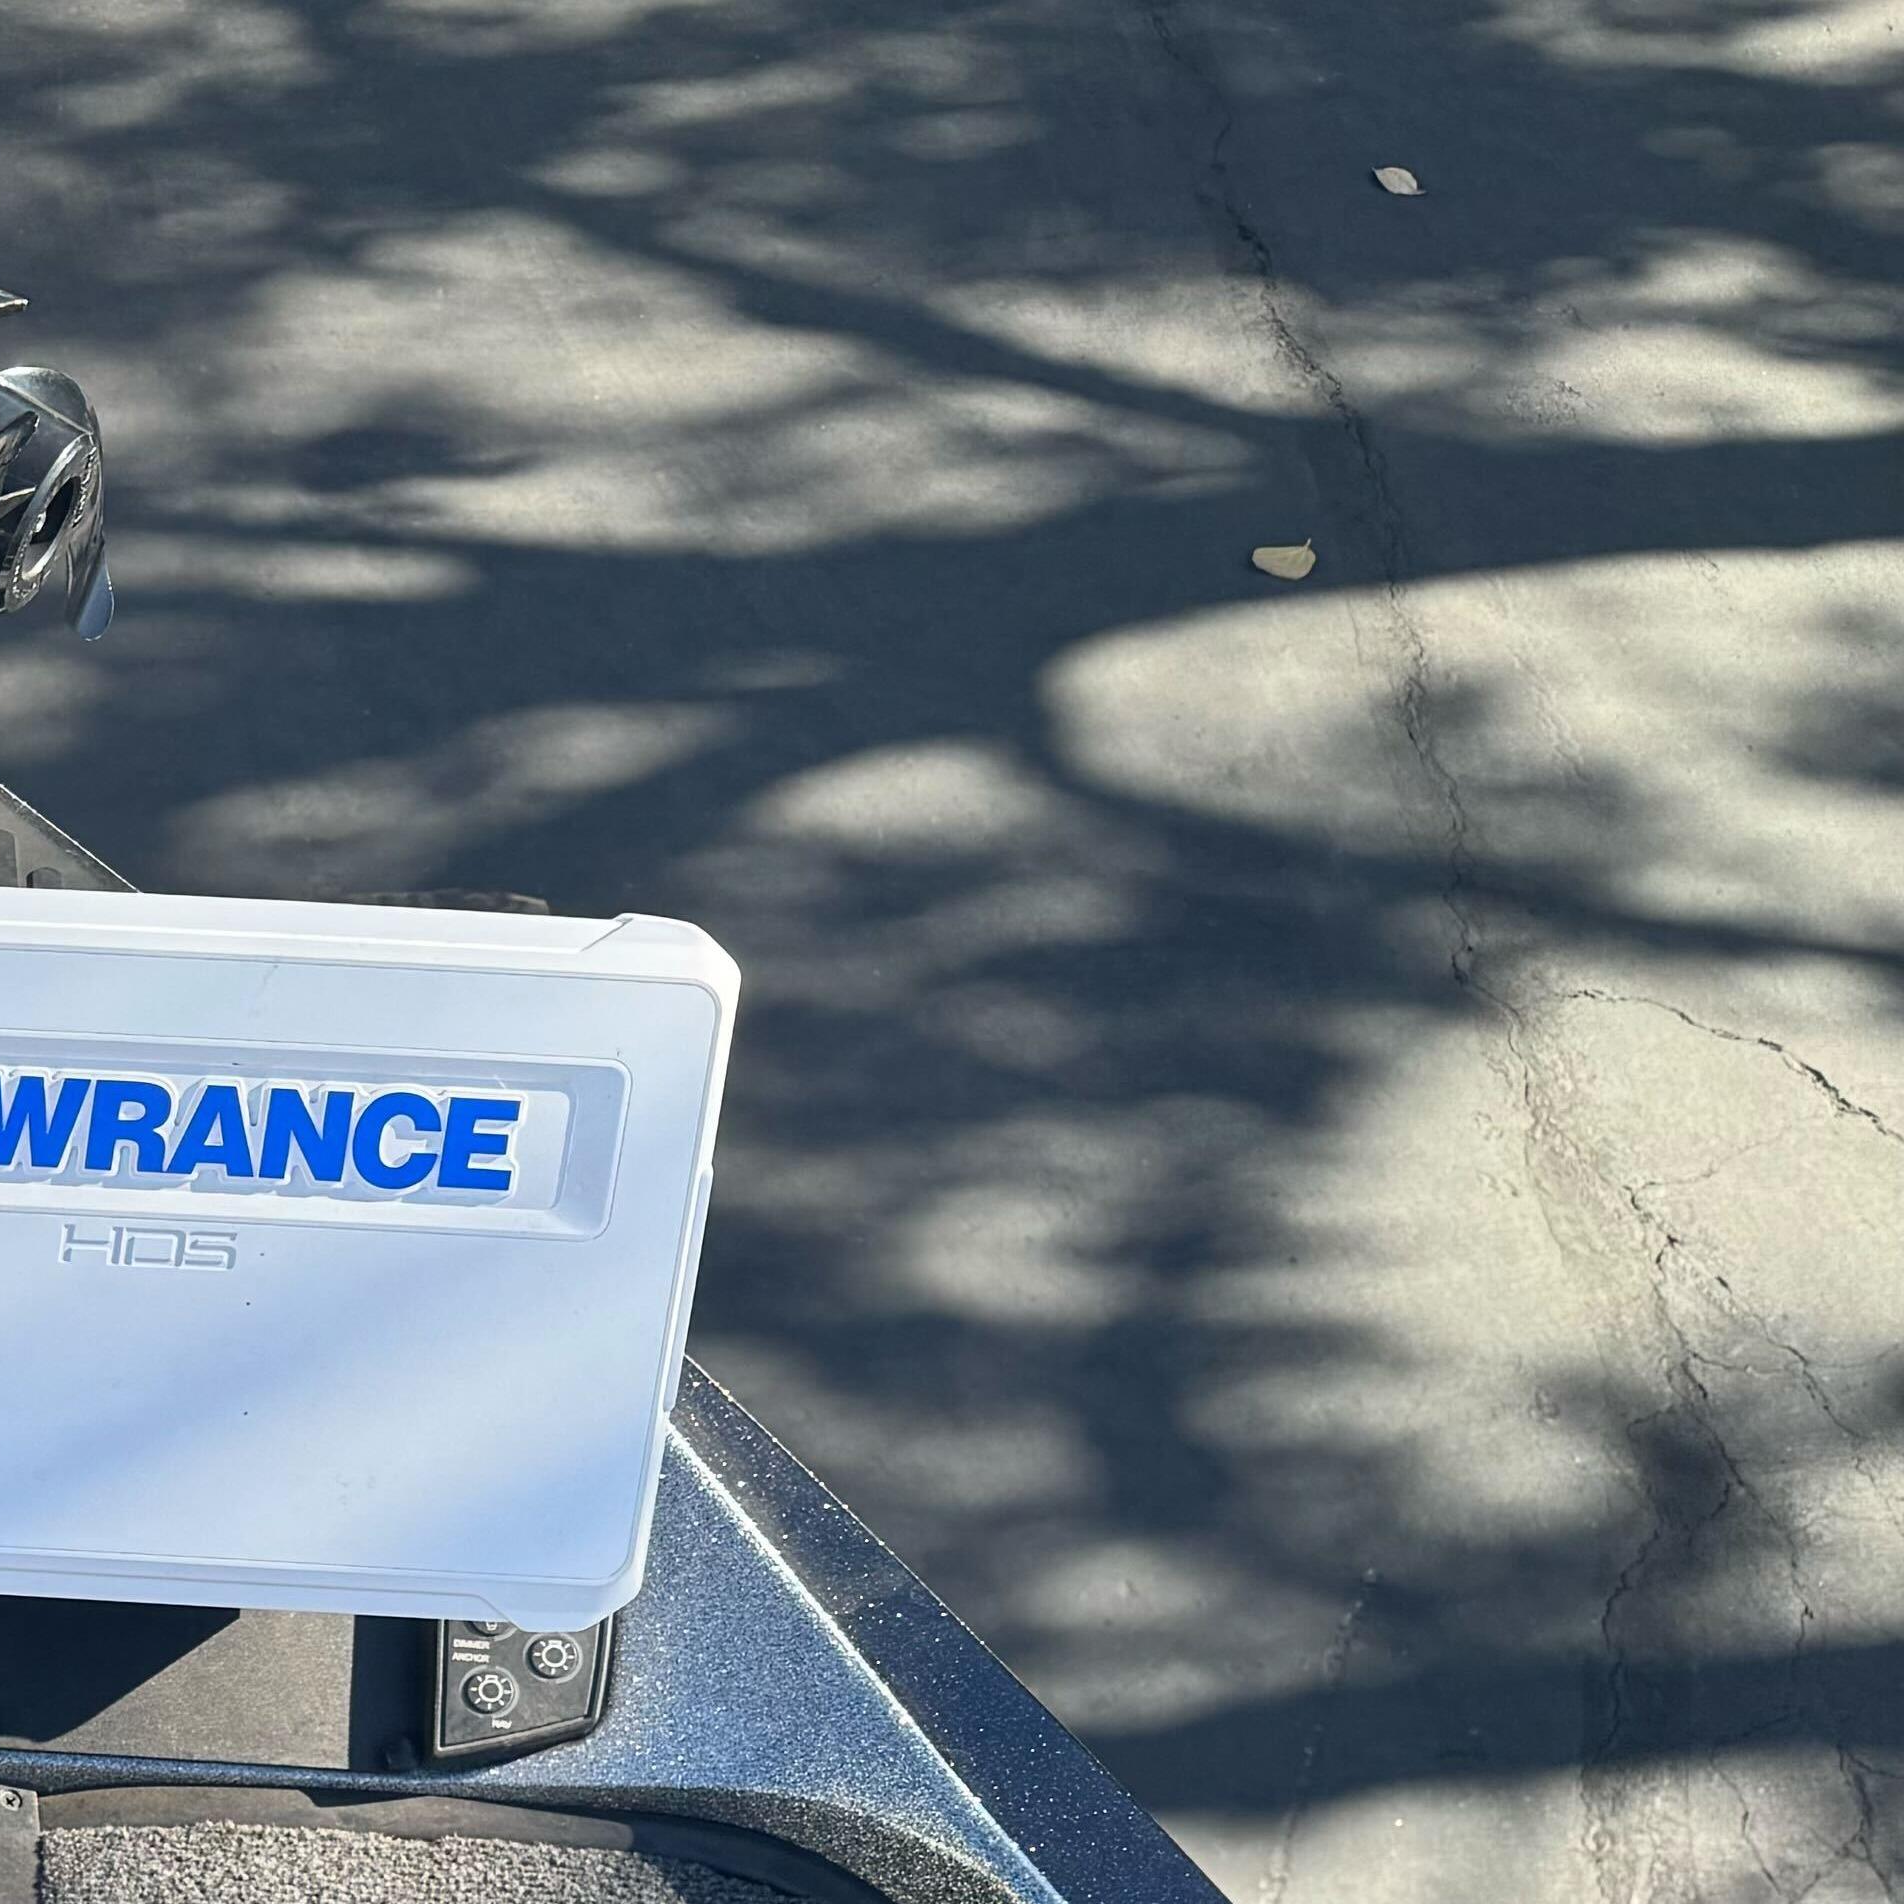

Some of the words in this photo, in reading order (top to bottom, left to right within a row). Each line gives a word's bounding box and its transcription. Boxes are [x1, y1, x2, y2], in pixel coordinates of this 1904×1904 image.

[58, 1223, 238, 1272] HDS
[453, 1638, 491, 1650] DIMMER
[451, 1651, 490, 1665] ANCHOR
